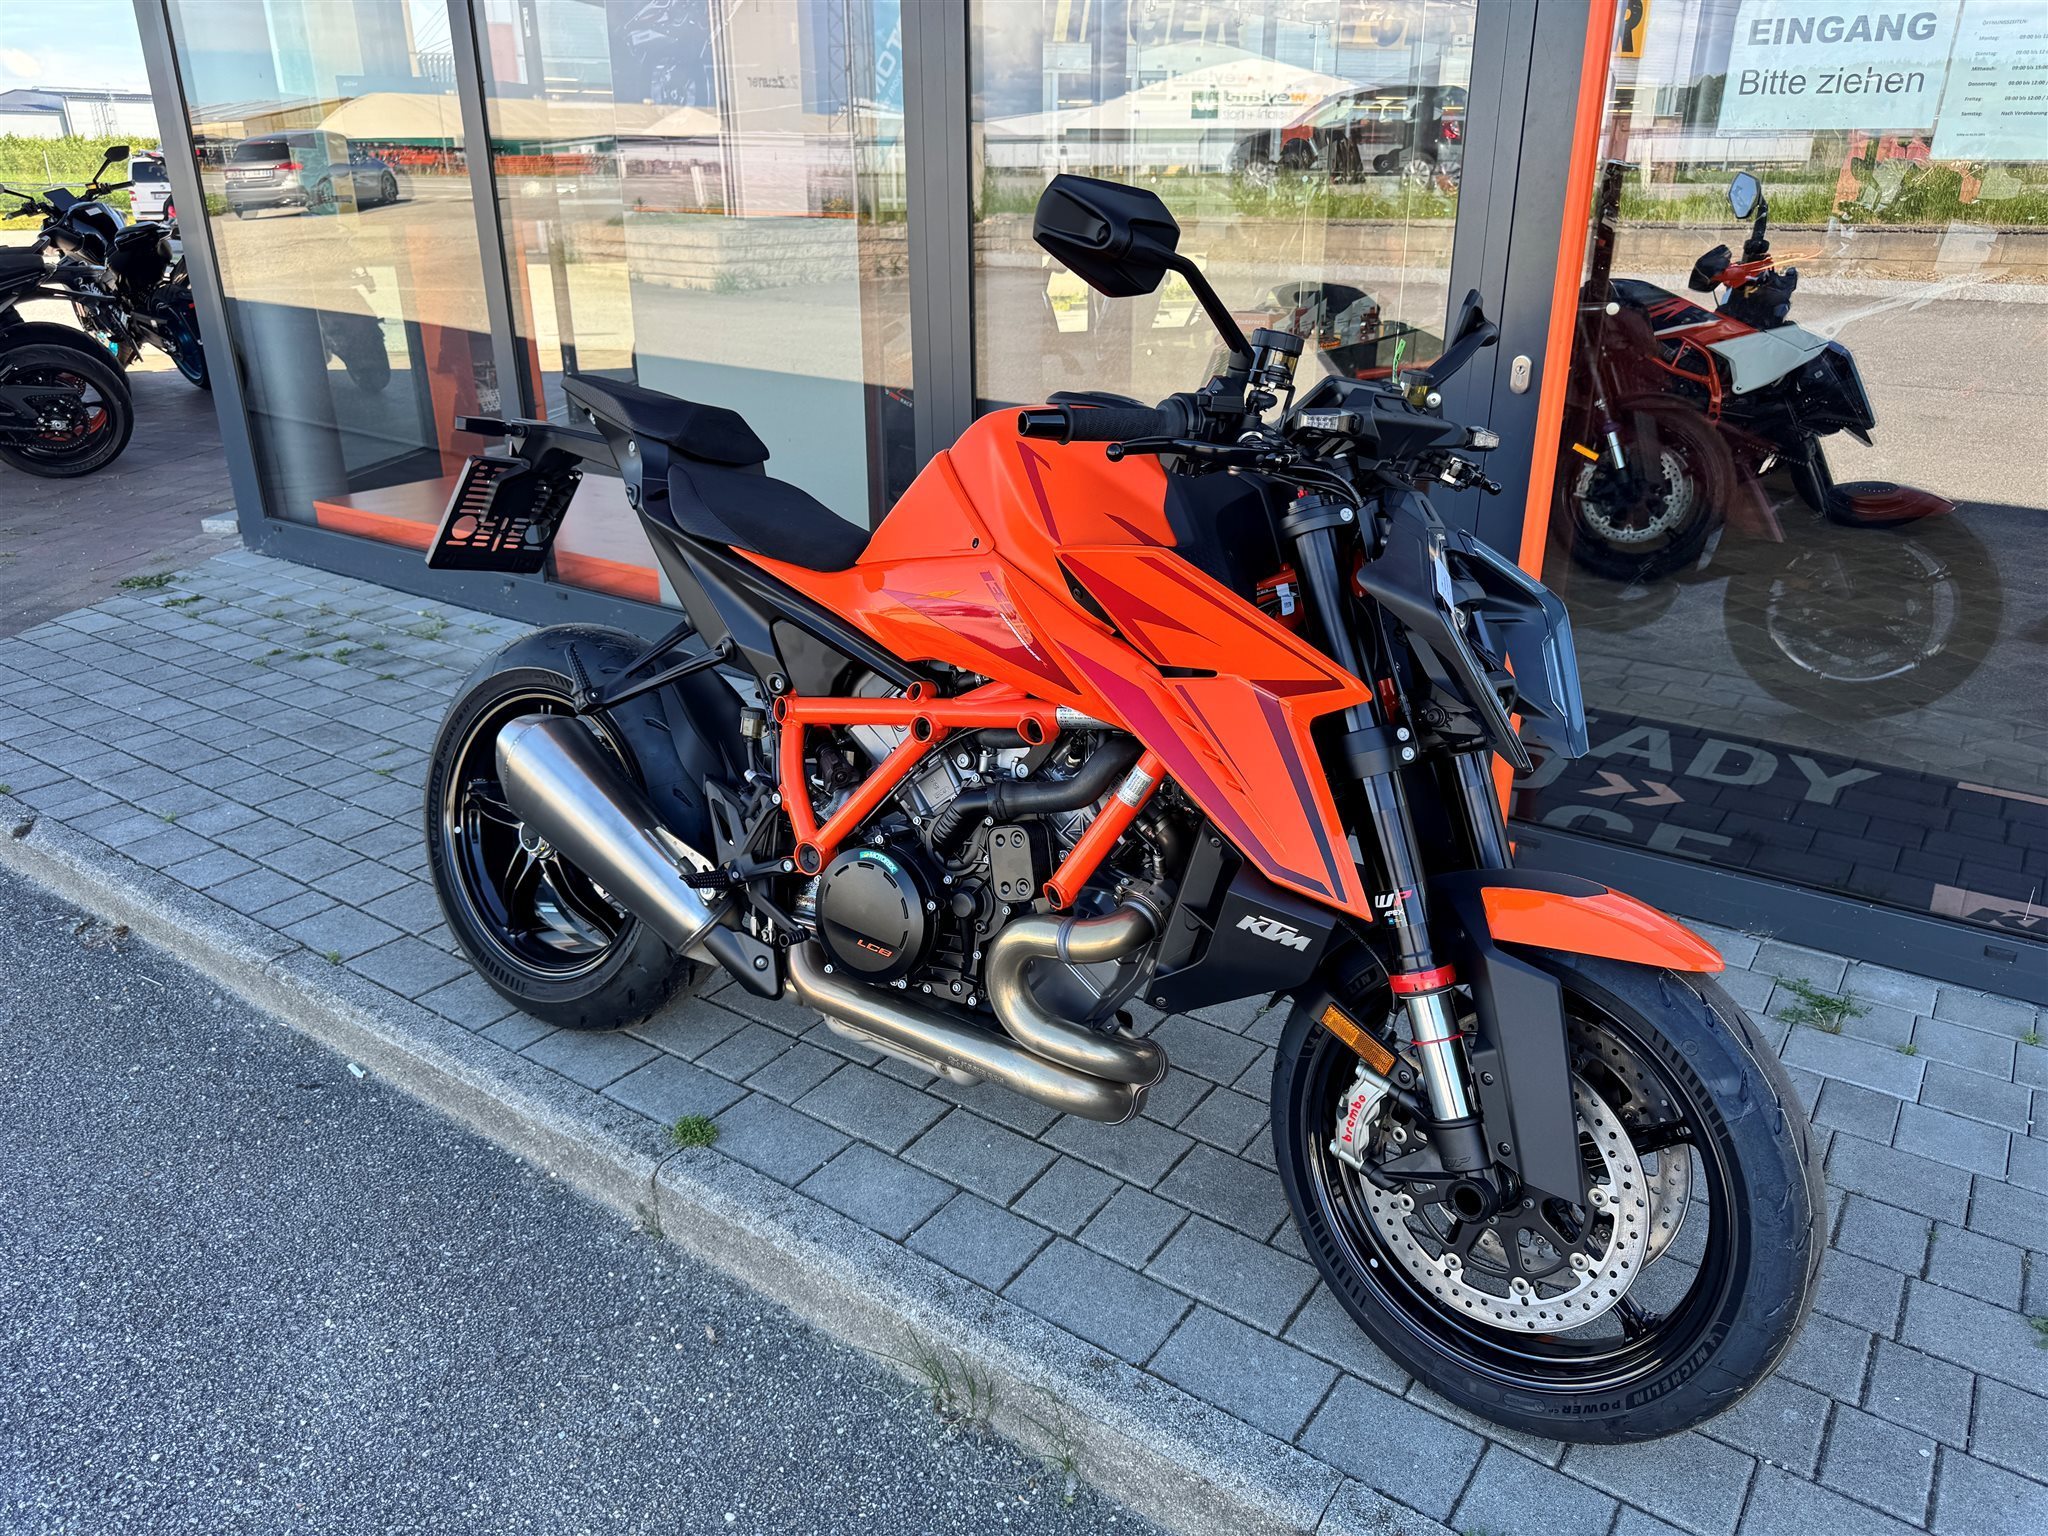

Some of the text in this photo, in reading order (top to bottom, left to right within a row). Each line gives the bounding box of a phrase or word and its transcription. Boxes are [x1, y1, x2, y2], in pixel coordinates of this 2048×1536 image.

[1748, 12, 1937, 46] EINGANG
[1738, 66, 1925, 95] Bitte ziehen
[1588, 717, 1881, 805] ADY
[1375, 890, 1413, 908] WP
[1384, 909, 1404, 917] APEX
[857, 939, 893, 958] LC8
[1236, 915, 1312, 952] KTM
[1342, 1094, 1366, 1143] brembo
[1632, 1345, 1709, 1406] MICHELIN
[1562, 1400, 1620, 1415] POWER
